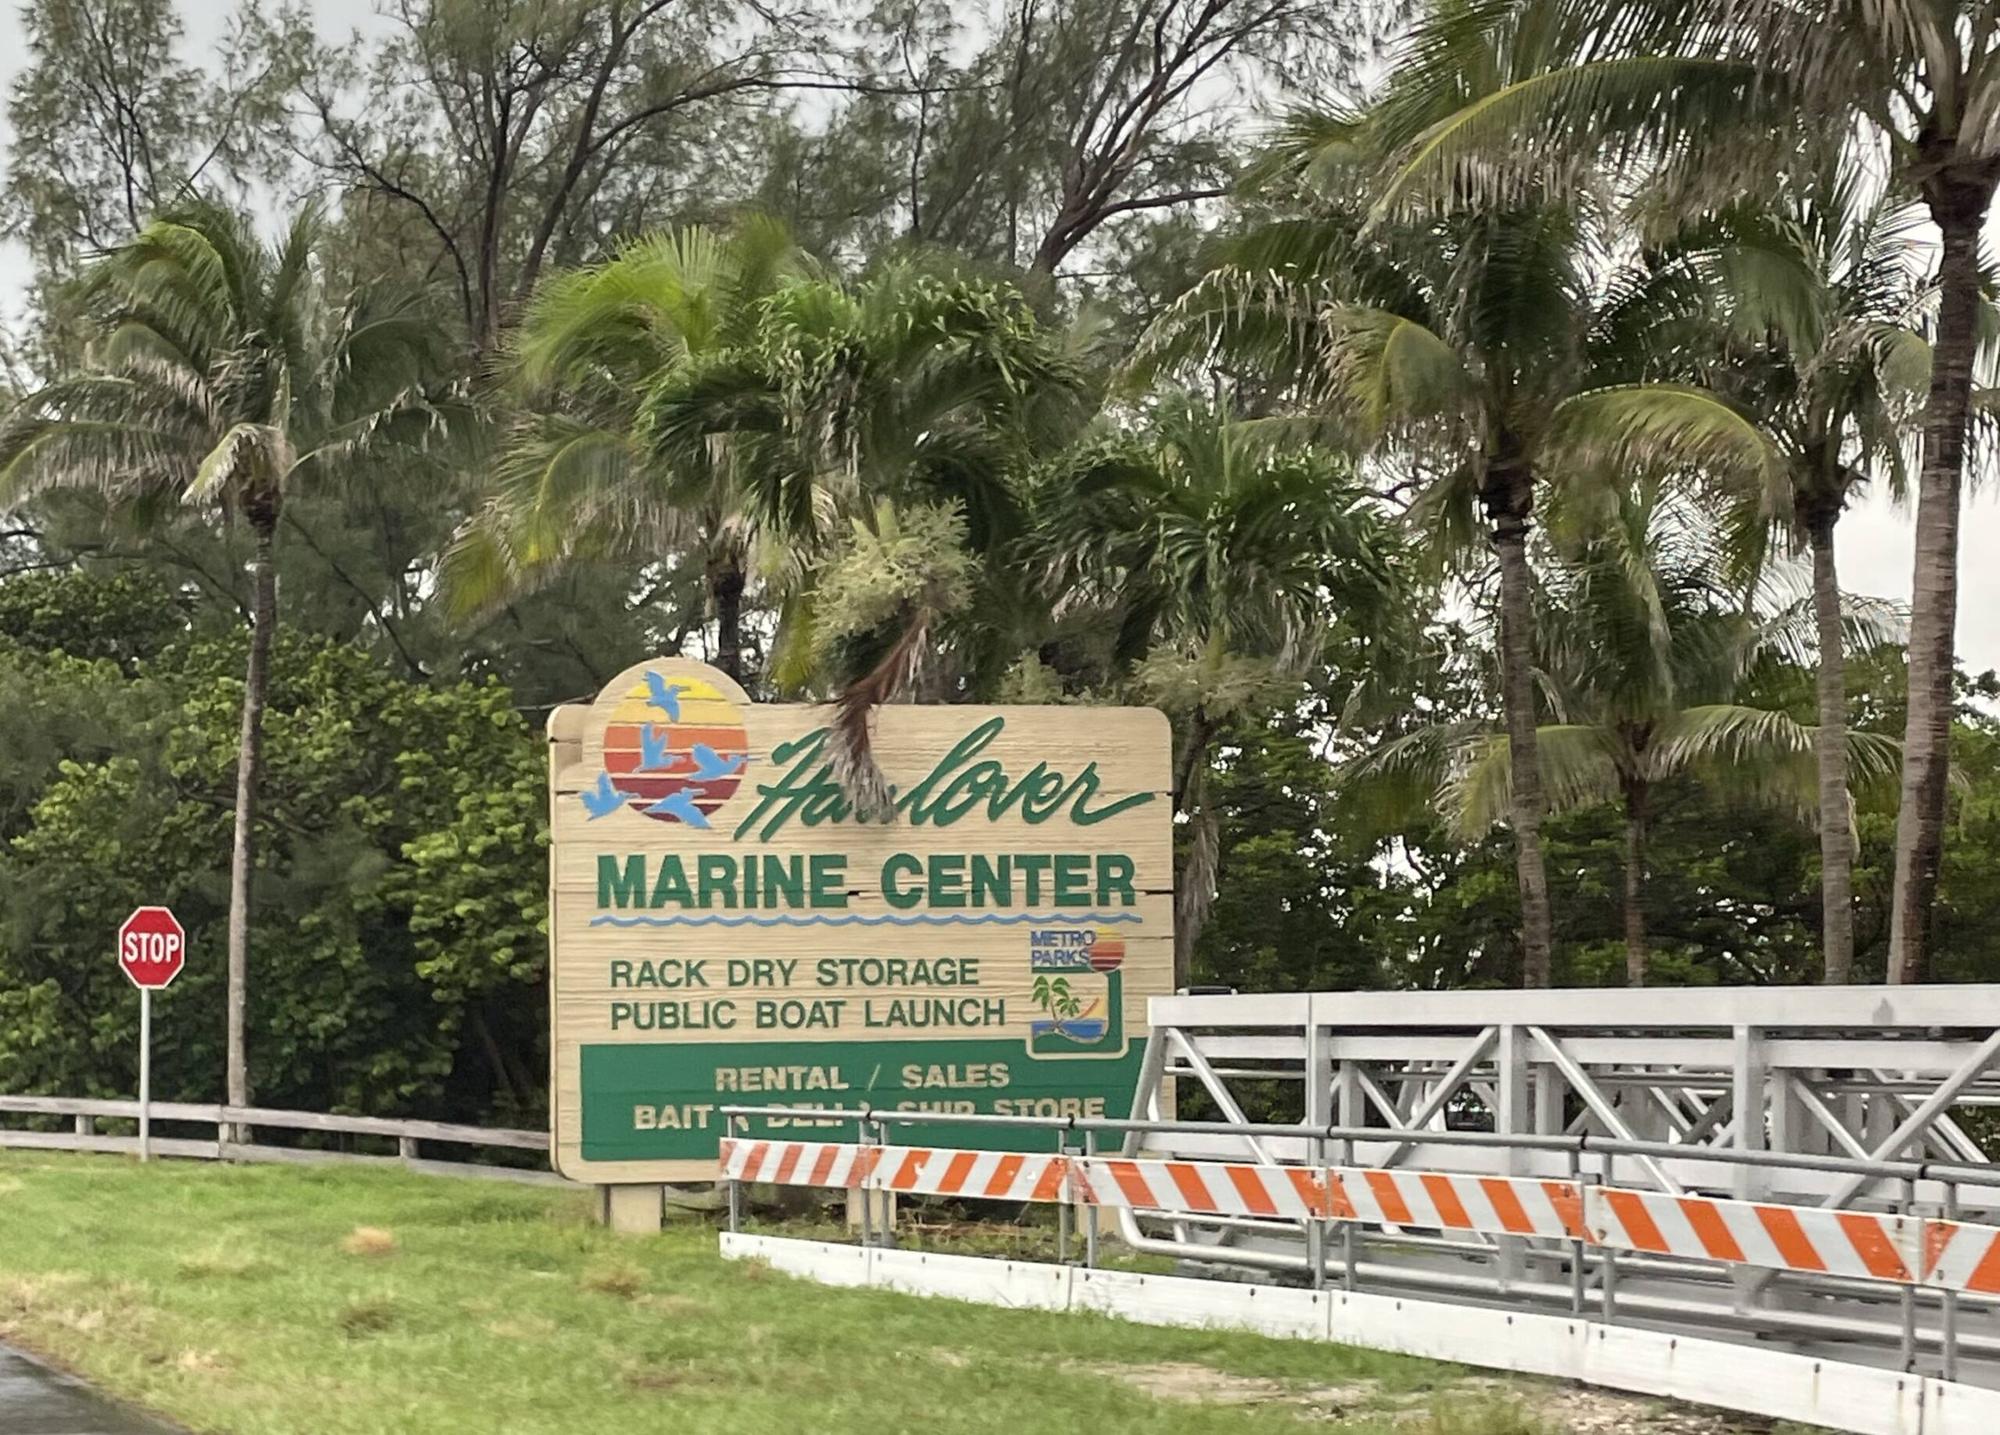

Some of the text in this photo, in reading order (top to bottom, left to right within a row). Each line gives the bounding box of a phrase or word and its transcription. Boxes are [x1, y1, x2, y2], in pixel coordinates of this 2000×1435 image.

[733, 715, 1156, 843] Halover
[597, 852, 1137, 909] MARINE CENTER
[124, 931, 180, 963] STOP
[1030, 929, 1097, 947] METRO
[610, 957, 980, 988] RACK DRY STORAGE
[1030, 947, 1090, 967] PARKS
[610, 997, 1006, 1030] PUBLIC BOAT LAUNCH
[715, 1065, 850, 1092] RENTAL
[902, 1063, 1011, 1088] SALES
[633, 1103, 714, 1130] BAIT
[993, 1096, 1106, 1122] STORE
